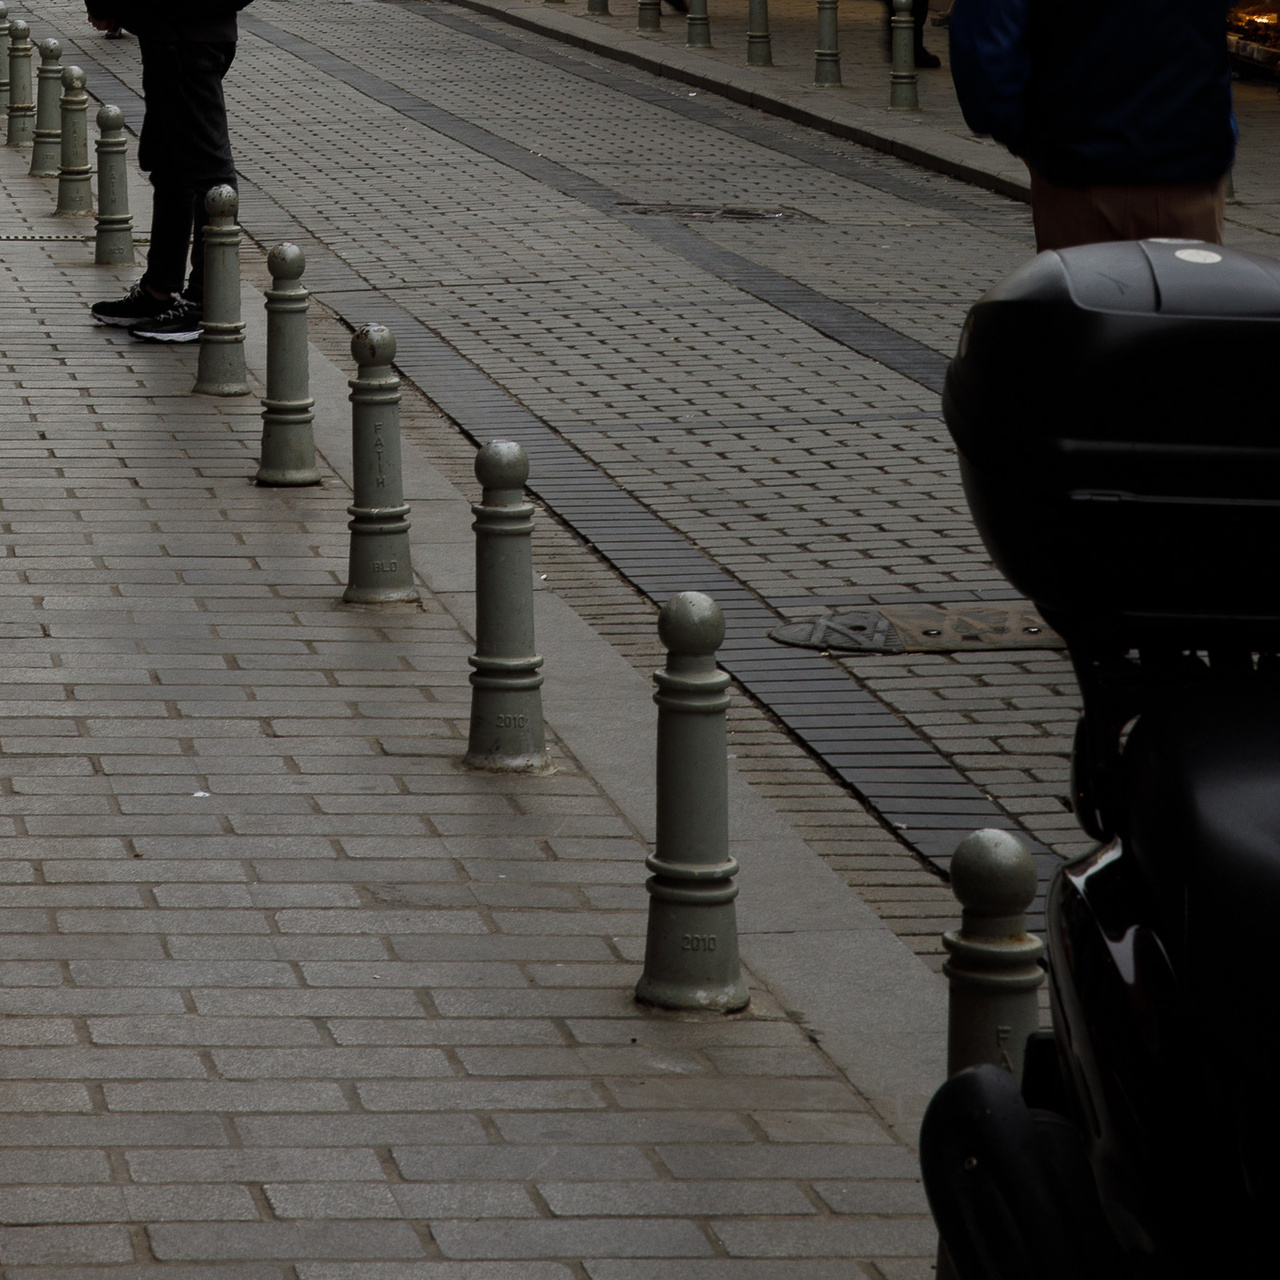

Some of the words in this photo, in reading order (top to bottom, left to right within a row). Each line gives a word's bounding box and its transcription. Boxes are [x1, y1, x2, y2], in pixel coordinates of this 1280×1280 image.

[373, 422, 387, 488] FATIH
[495, 713, 525, 729] 2010
[681, 933, 717, 951] 2010
